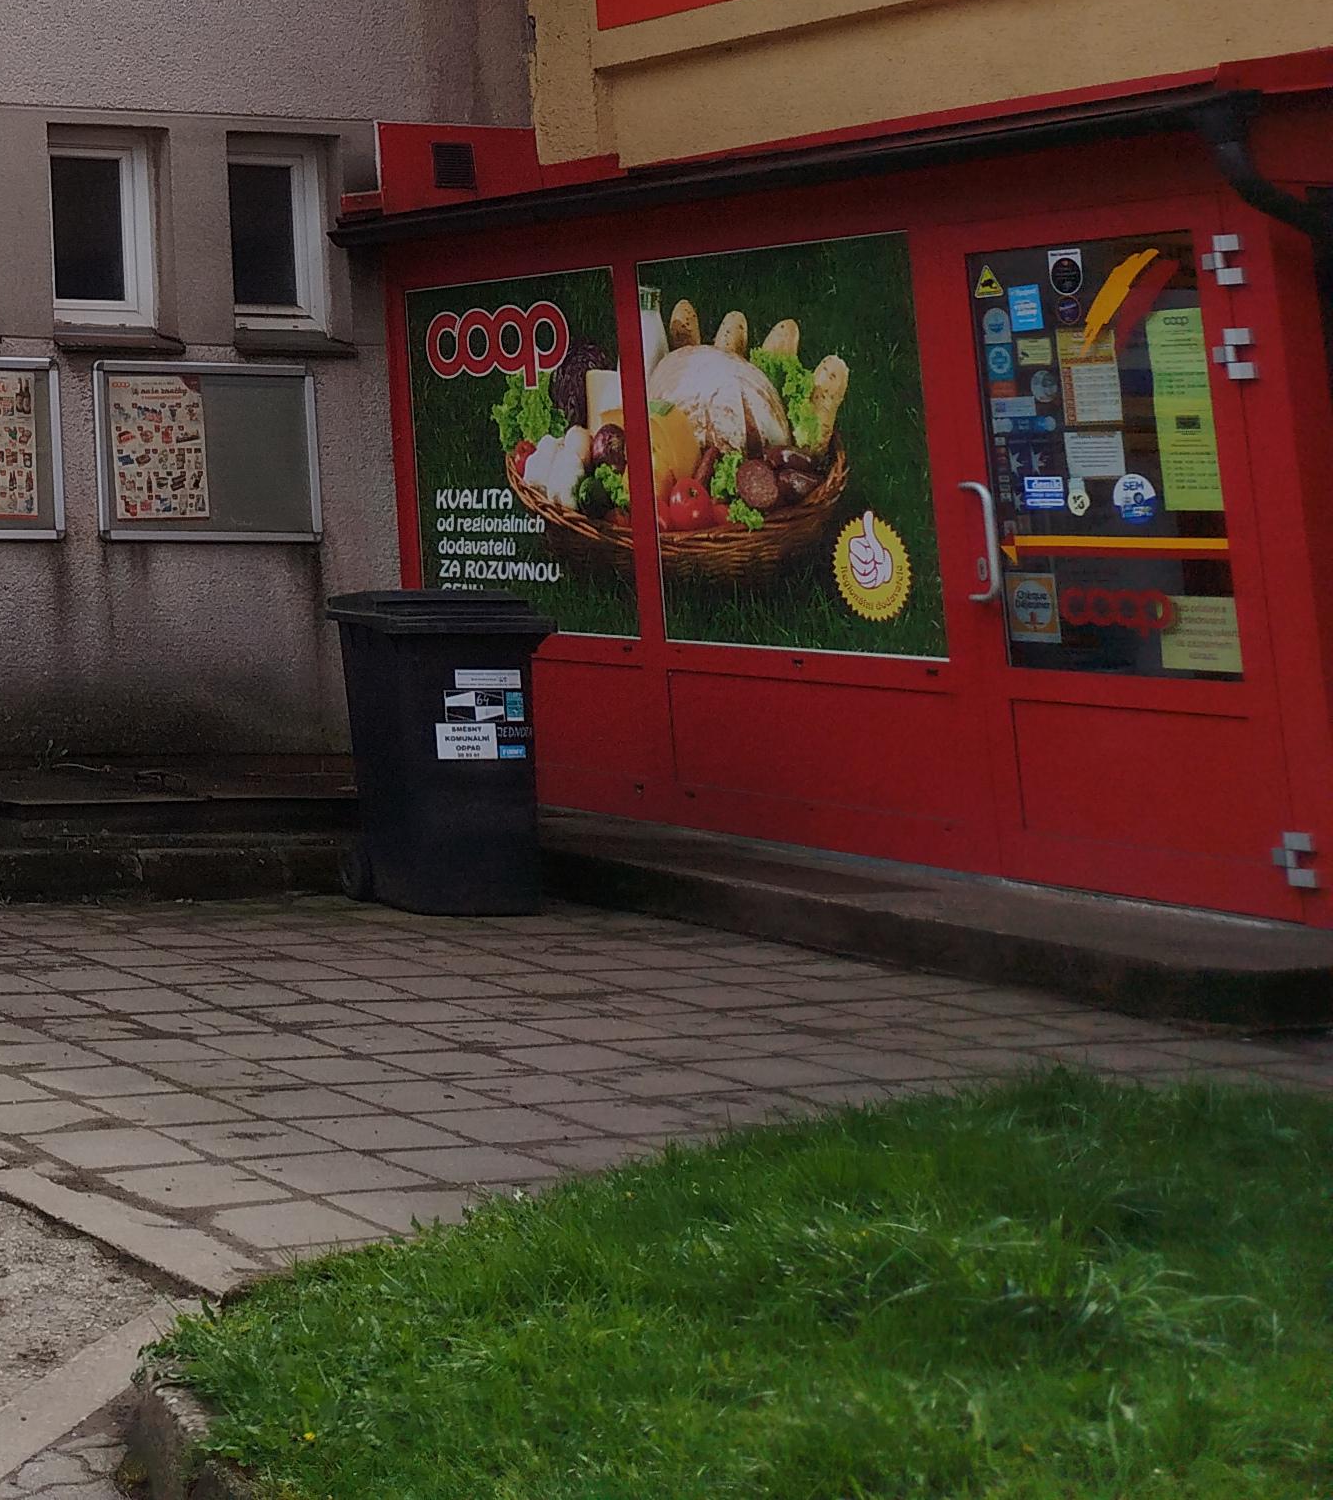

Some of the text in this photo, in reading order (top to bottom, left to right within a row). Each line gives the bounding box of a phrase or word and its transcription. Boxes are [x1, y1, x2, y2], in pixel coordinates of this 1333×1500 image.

[425, 301, 570, 389] coop
[435, 488, 513, 510] KVALITA
[436, 514, 546, 533] od regionálních
[438, 537, 517, 556] dodavatelů
[439, 560, 560, 582] ZA ROZUMNOU
